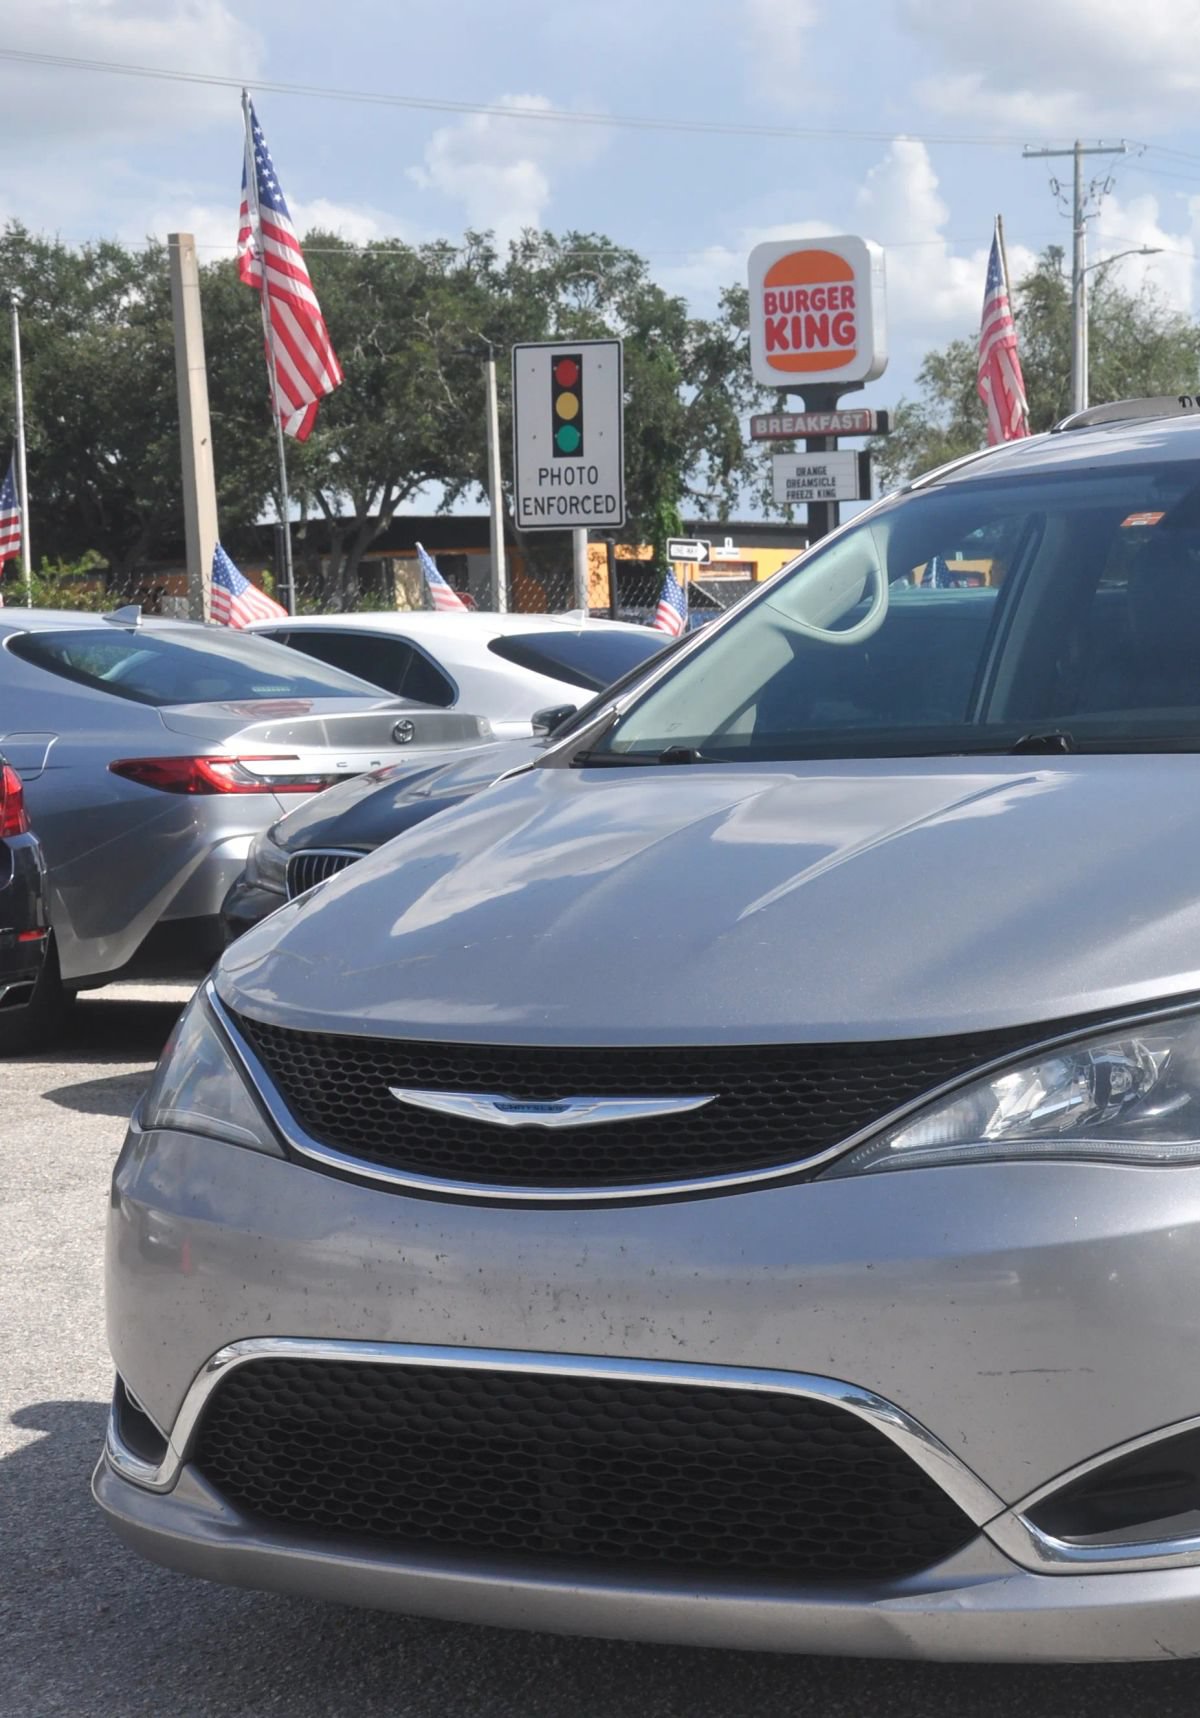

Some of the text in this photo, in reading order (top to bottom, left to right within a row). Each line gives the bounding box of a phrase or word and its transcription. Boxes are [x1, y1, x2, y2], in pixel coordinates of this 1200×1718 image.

[764, 285, 855, 316] BURGER
[765, 311, 856, 352] KING
[756, 414, 864, 434] BREAKFAST
[538, 465, 599, 486] PHOTO
[796, 466, 827, 477] ORANGE
[786, 477, 836, 488] DREAMSICLE
[787, 488, 836, 499] FREEZE KING
[523, 494, 616, 516] ENFORCED
